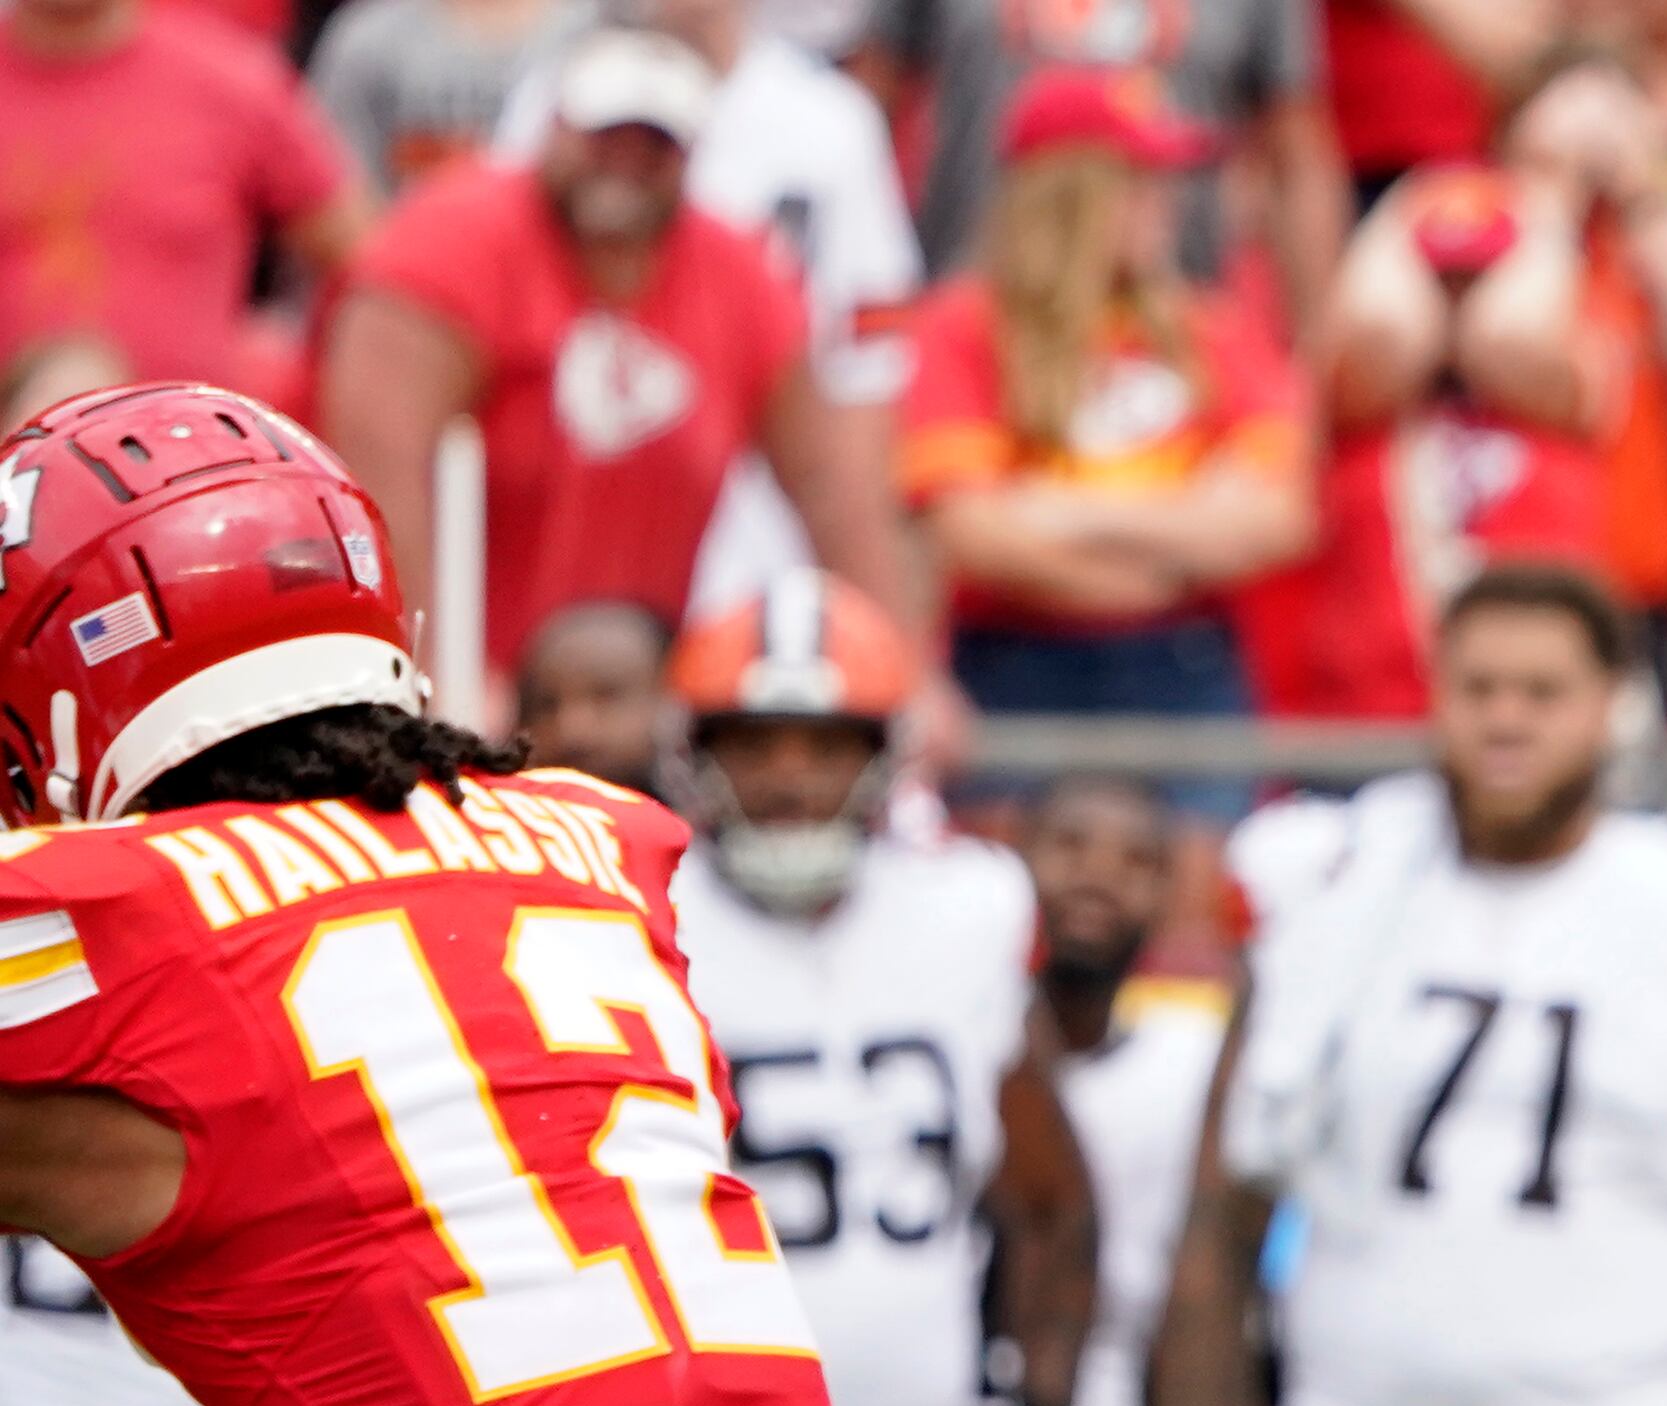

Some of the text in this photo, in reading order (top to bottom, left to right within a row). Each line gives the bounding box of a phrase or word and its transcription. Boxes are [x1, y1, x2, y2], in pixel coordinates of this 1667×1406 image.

[145, 776, 649, 931] HAILASSIE
[281, 907, 821, 1404] 12
[724, 1036, 958, 1250] 53
[1400, 983, 1578, 1207] 71
